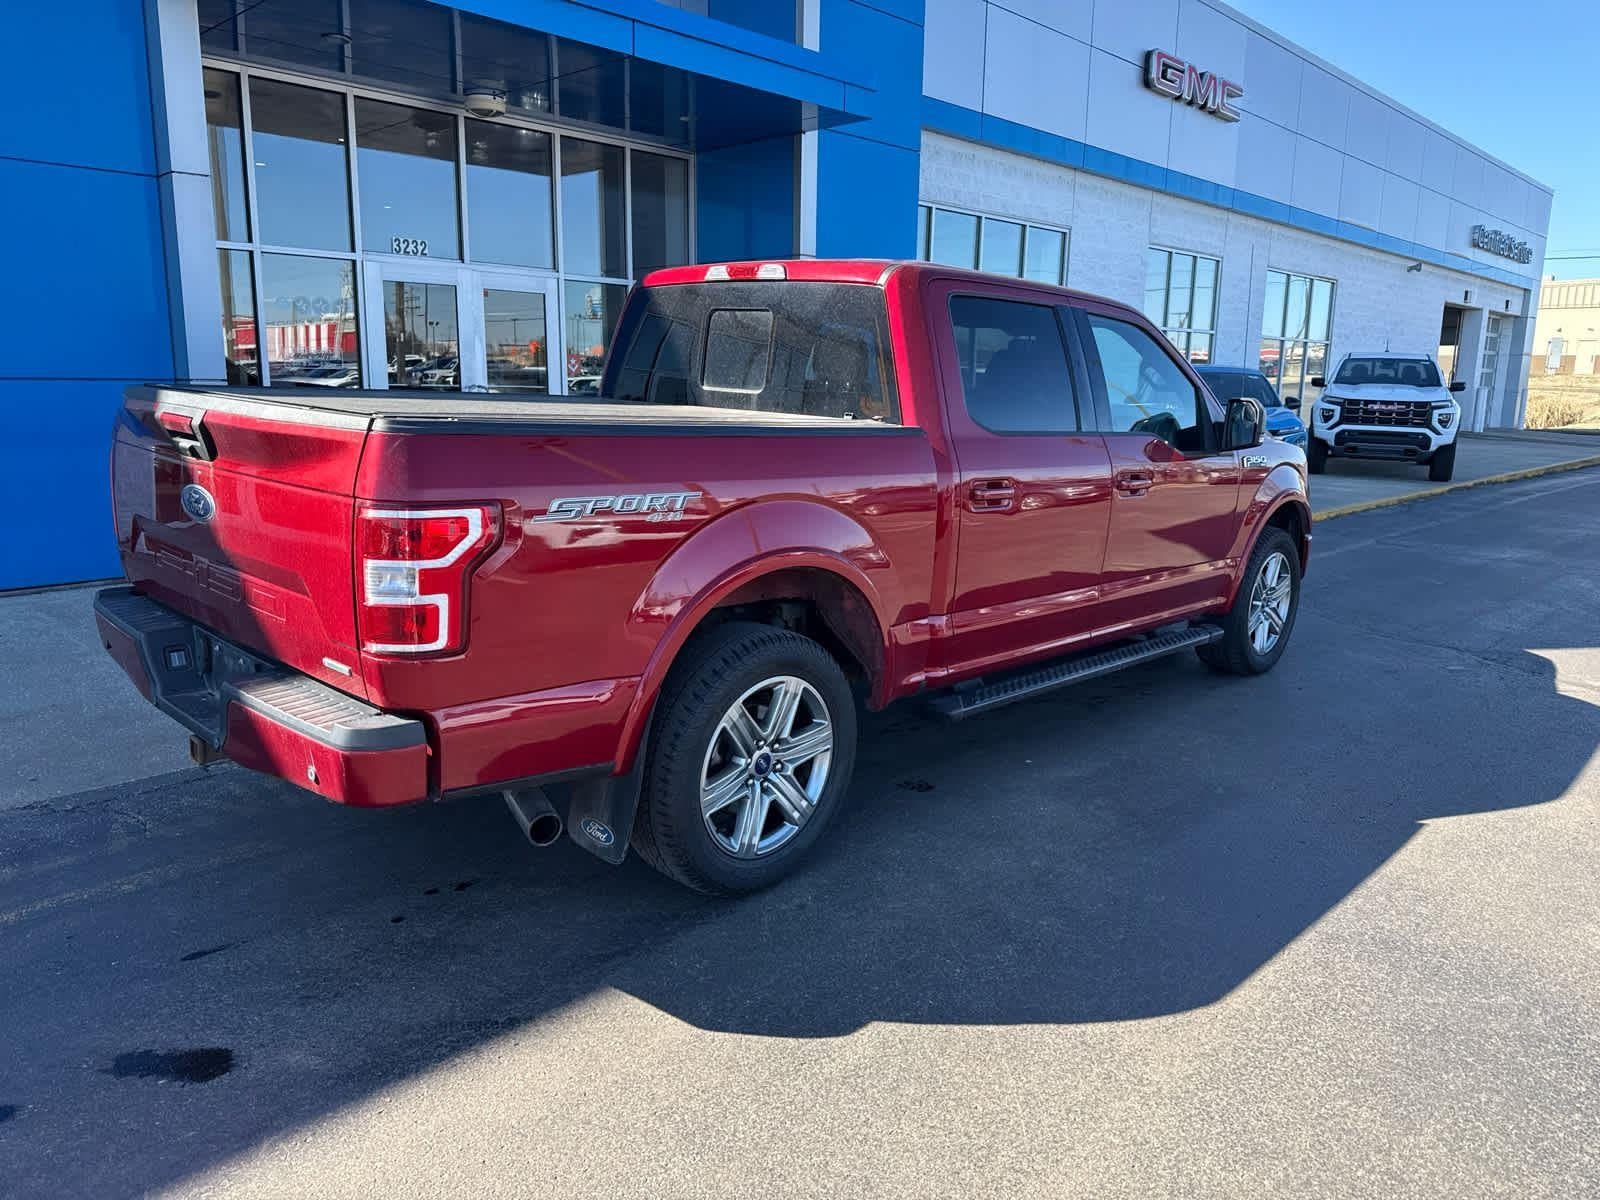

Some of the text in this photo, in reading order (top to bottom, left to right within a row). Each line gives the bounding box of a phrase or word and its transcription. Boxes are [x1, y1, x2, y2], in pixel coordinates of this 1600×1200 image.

[1144, 48, 1243, 122] GMC
[393, 237, 428, 256] 3232
[532, 491, 703, 524] SPORT
[586, 821, 608, 842] Ford
